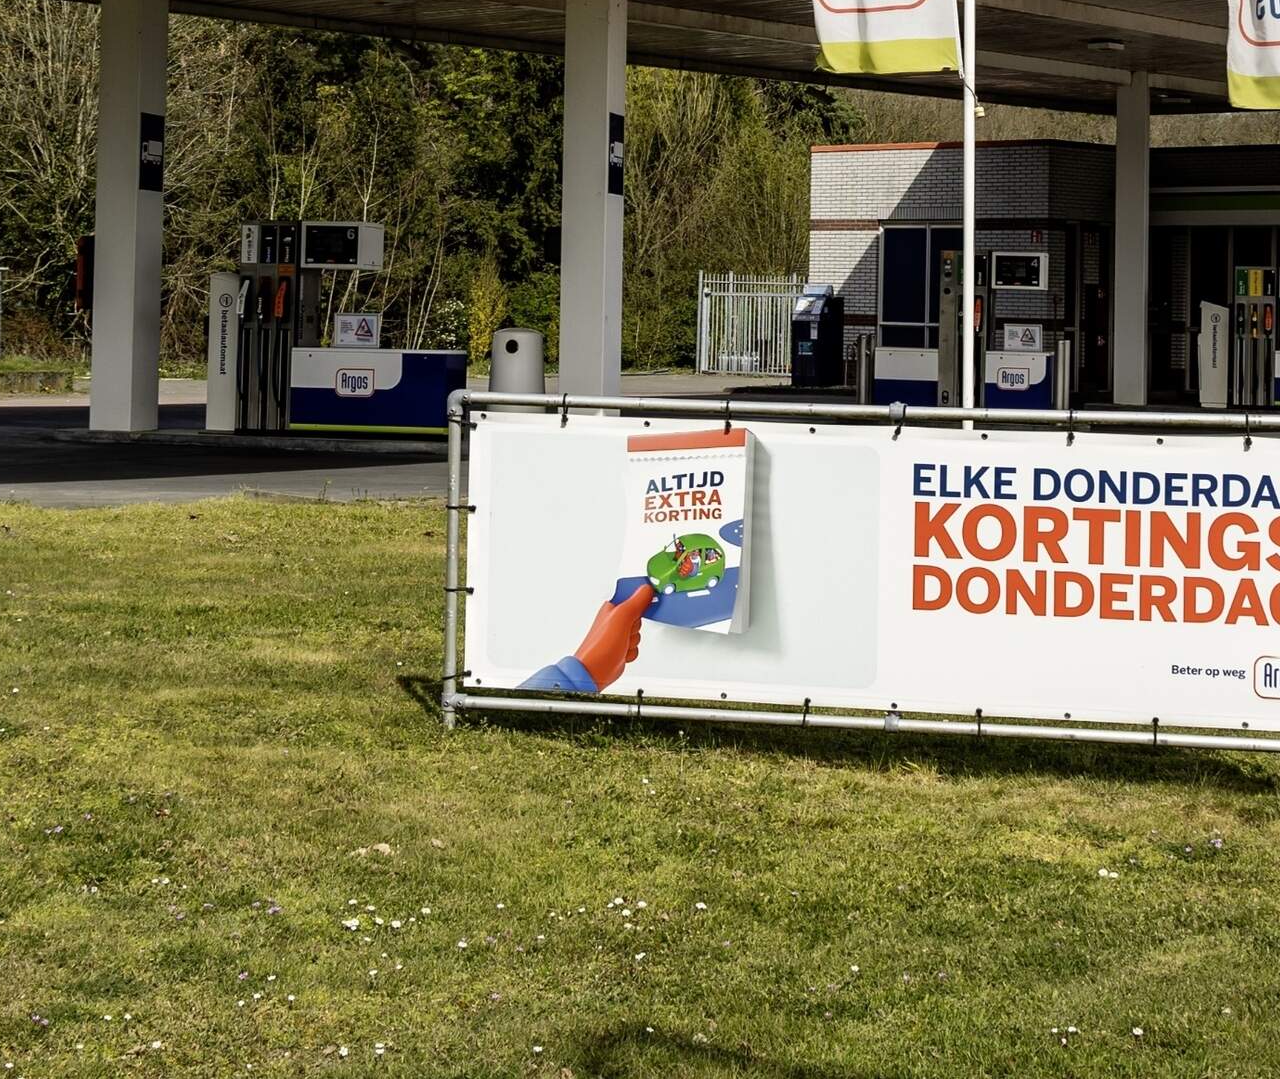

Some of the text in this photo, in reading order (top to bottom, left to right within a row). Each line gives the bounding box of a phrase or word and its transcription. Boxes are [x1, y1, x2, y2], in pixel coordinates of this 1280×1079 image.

[346, 228, 356, 240] 6
[219, 309, 229, 375] betaalautomaat
[341, 372, 369, 393] Argos
[1001, 370, 1025, 387] Argos
[646, 471, 725, 495] ALTIJD
[913, 463, 1018, 500] ELKE
[644, 489, 723, 511] EXTRA
[643, 508, 723, 524] KORTING
[1171, 664, 1246, 680] Beter op weg
